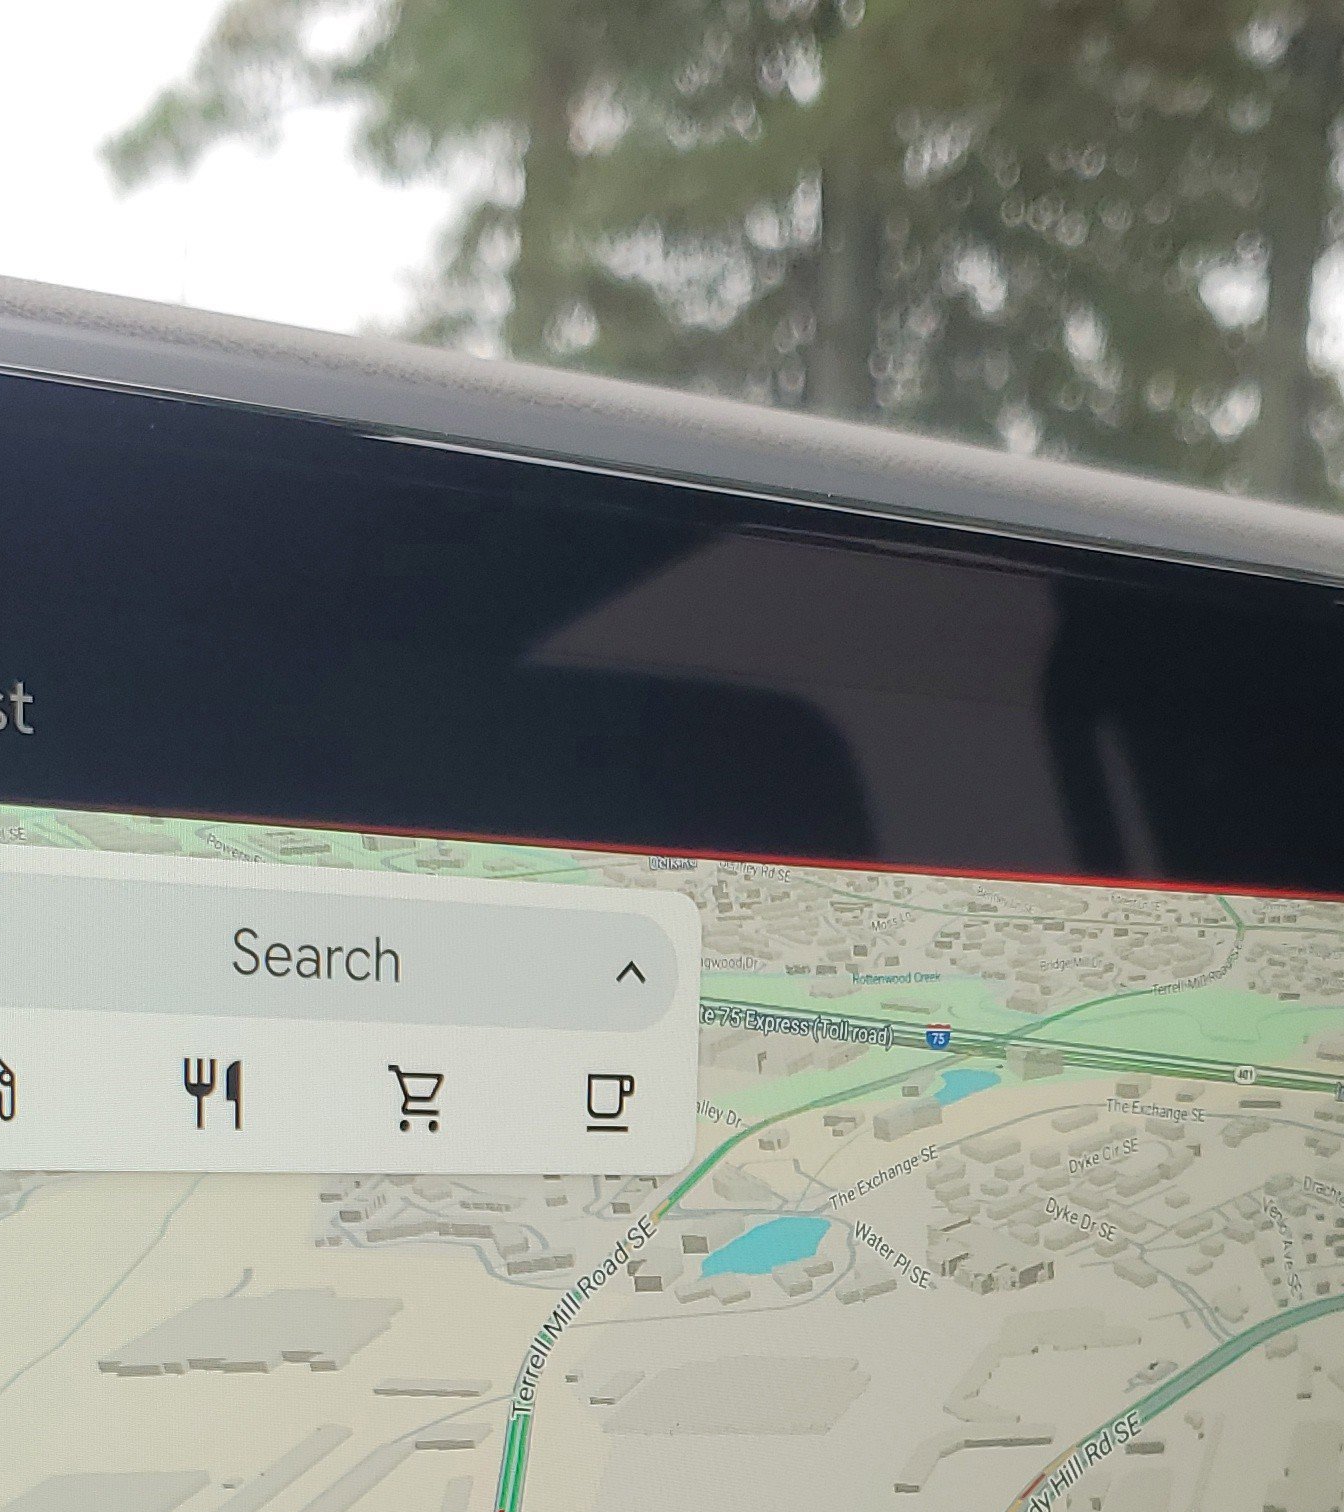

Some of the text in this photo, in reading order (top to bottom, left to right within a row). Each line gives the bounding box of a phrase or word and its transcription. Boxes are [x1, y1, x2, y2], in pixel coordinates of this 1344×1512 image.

[778, 868, 791, 882] SE
[232, 928, 401, 983] Search
[719, 1006, 741, 1028] 75
[744, 1010, 808, 1037] Express
[811, 1014, 848, 1043] (Toll
[850, 1024, 895, 1051] road)
[931, 1033, 945, 1045] 75
[726, 1111, 742, 1128] Dr
[1107, 1098, 1206, 1123] The Exchange SE
[829, 1144, 939, 1210] The Exchange SE
[1069, 1153, 1099, 1174] Dyke
[1122, 1138, 1138, 1155] SE
[1045, 1197, 1117, 1242] Dyke Dr SE
[855, 1220, 931, 1289] Water Pl SE
[511, 1214, 658, 1420] Terrell Mill Road SE
[1049, 1455, 1085, 1497] Hill
[1083, 1430, 1113, 1466] Rd
[1113, 1411, 1143, 1446] SE
